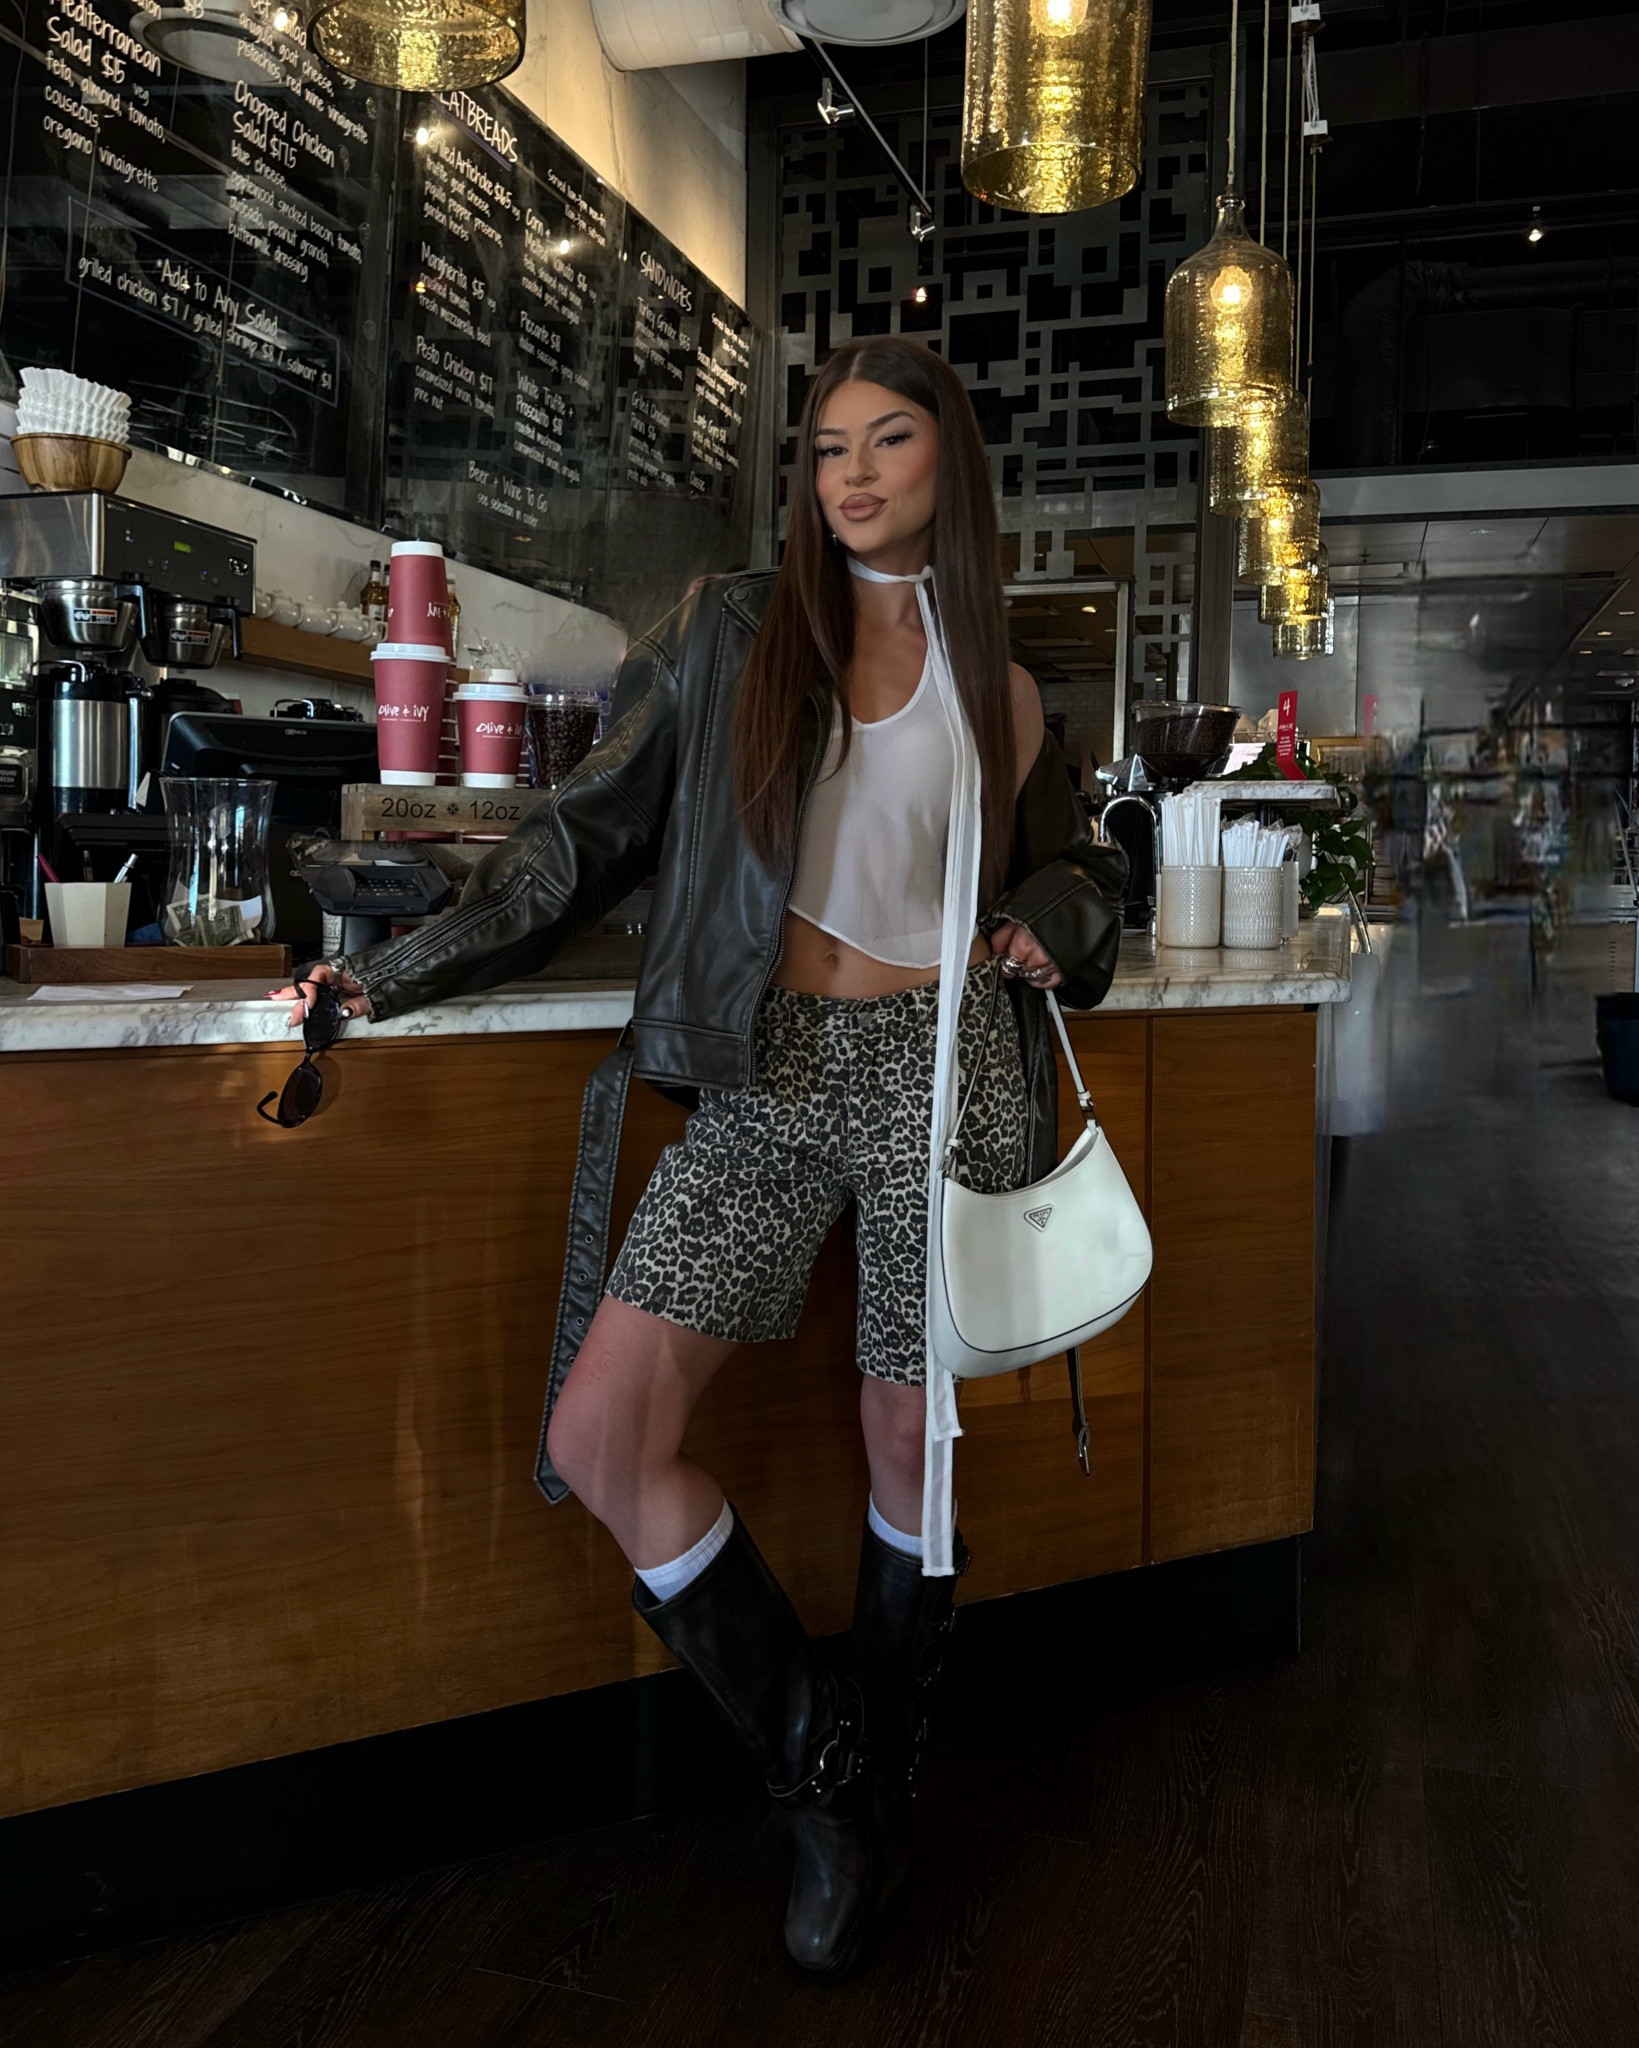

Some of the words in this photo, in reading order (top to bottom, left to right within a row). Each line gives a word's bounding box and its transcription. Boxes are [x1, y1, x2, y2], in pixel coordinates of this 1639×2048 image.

[46, 15, 93, 67] Salad
[100, 50, 127, 84] $15
[44, 84, 101, 134] couscous,
[45, 49, 75, 88] feta,
[79, 75, 122, 116] almond,
[126, 101, 166, 143] tomato,
[286, 73, 302, 97] red
[304, 87, 324, 113] wine
[232, 110, 268, 153] Salad
[233, 79, 288, 140] Chopped
[292, 119, 336, 169] Chicken
[432, 91, 518, 163] LATBREADS
[43, 114, 93, 155] oregano
[97, 145, 159, 193] vinaigrette
[229, 138, 252, 167] blue
[273, 244, 309, 284] dressing
[640, 251, 693, 313] SANDWICHES
[77, 256, 112, 286] grilled
[116, 271, 158, 307] chicken
[192, 310, 223, 338] grilled
[193, 274, 207, 302] to
[213, 284, 240, 328] Any
[245, 302, 278, 341] Salad
[417, 334, 440, 367] Pesto
[443, 351, 476, 388] Chicken
[469, 460, 491, 487] Beer
[503, 475, 524, 503] Wine
[525, 487, 537, 508] To
[1282, 696, 1291, 717] 4
[380, 796, 437, 819] 20oz
[469, 799, 521, 821] 12oz
